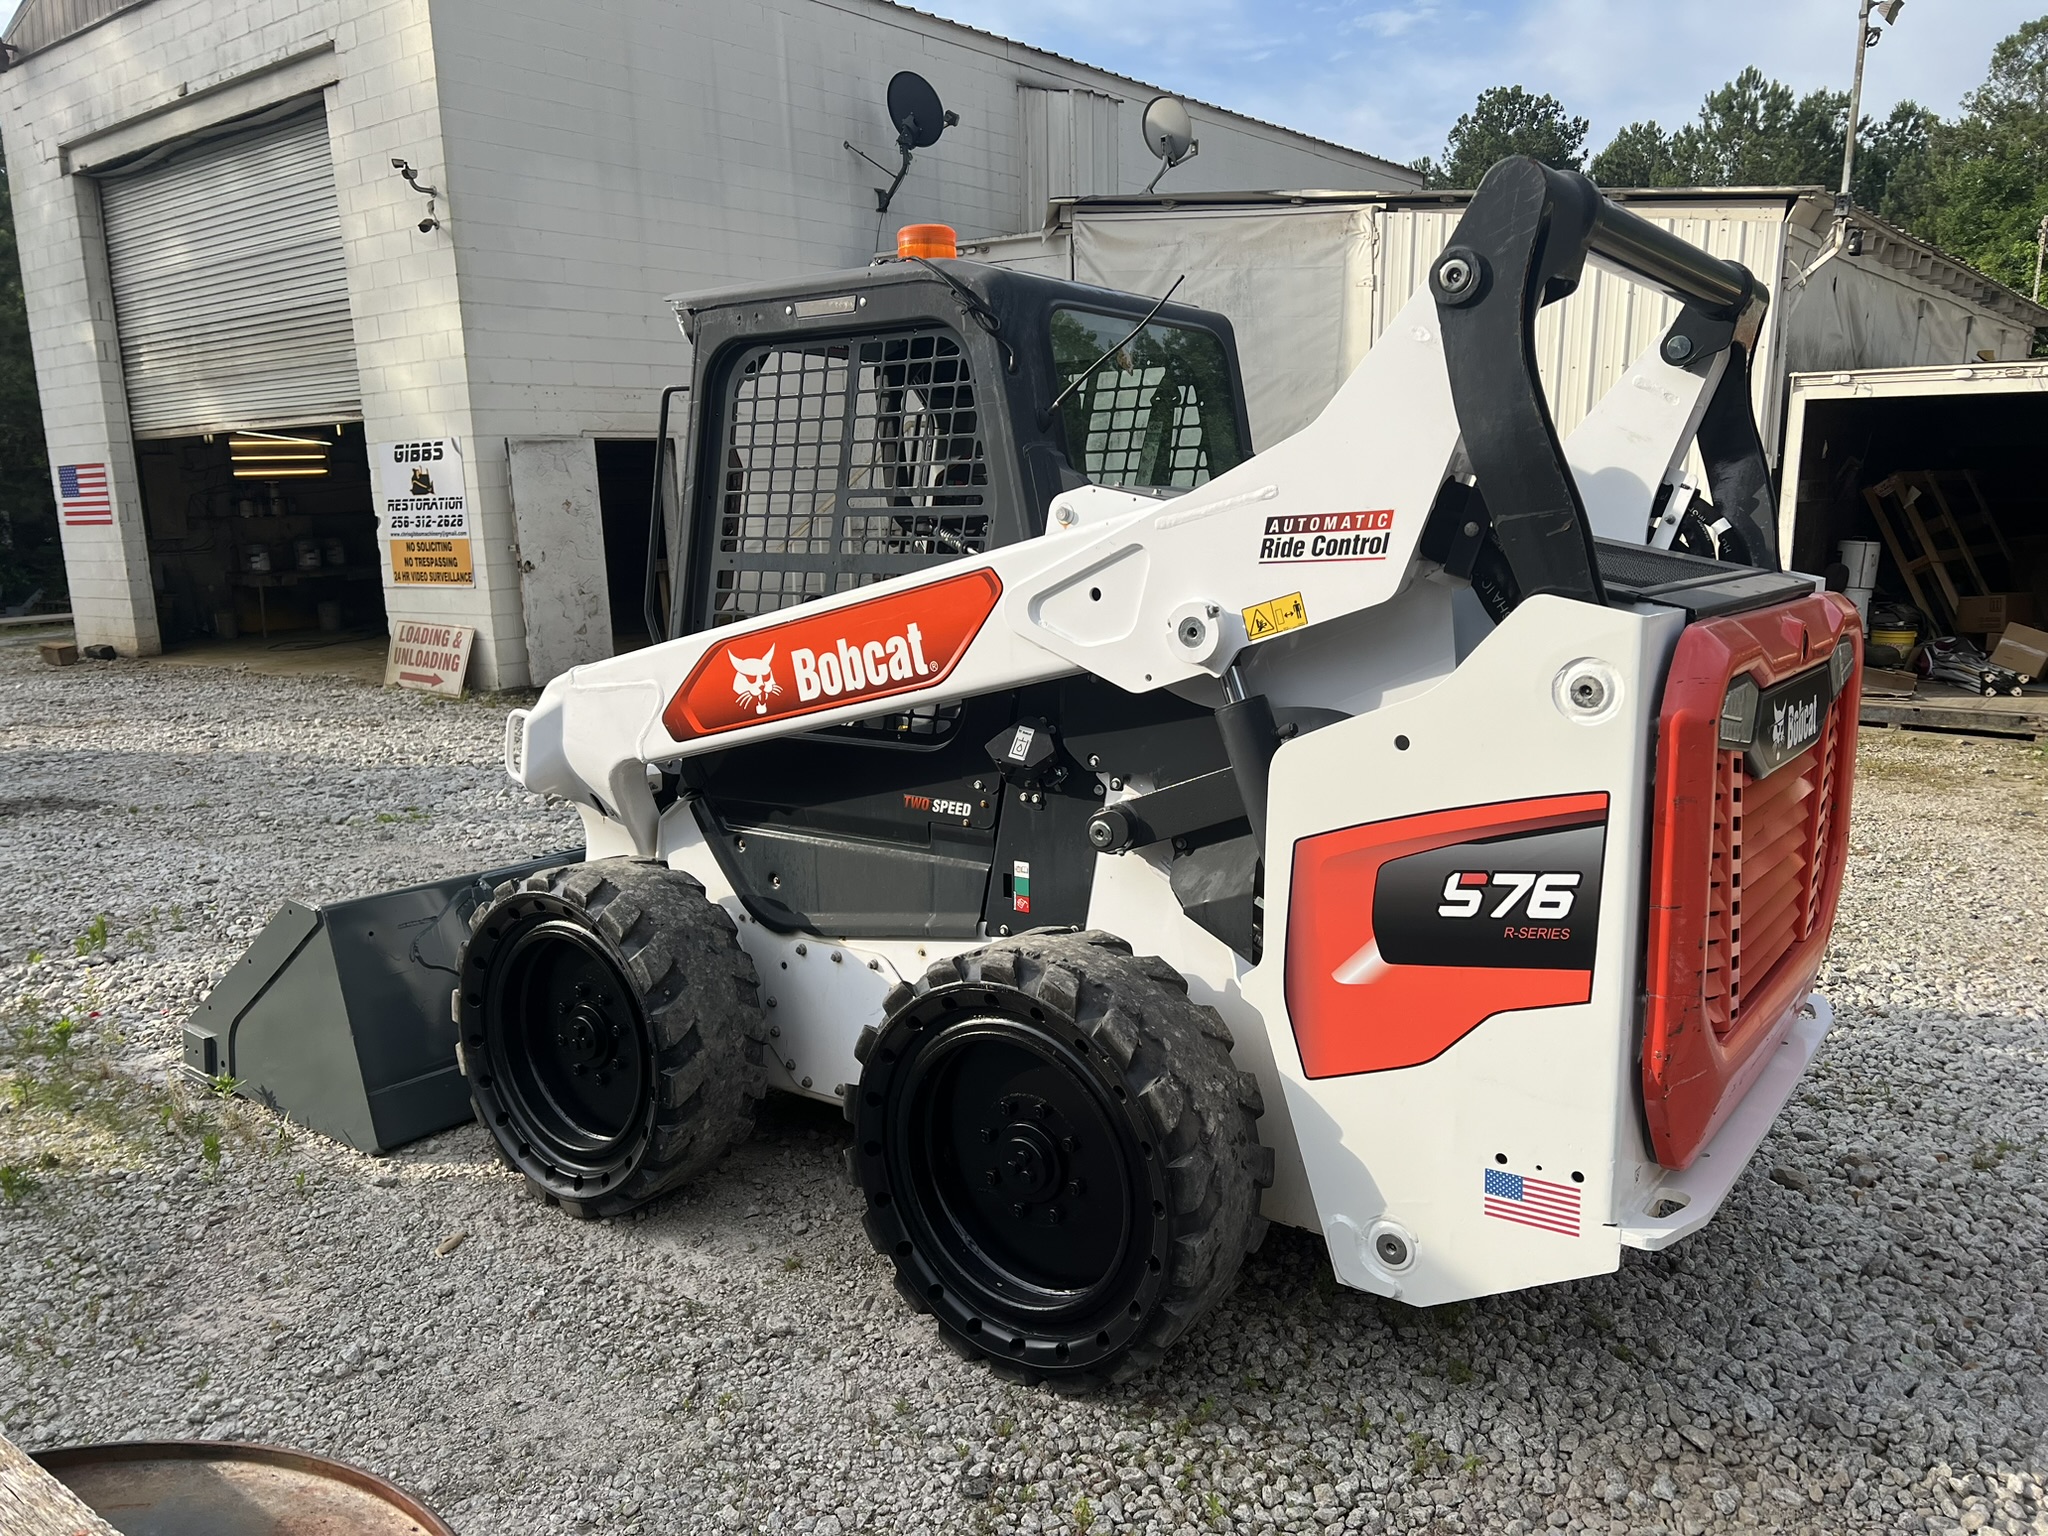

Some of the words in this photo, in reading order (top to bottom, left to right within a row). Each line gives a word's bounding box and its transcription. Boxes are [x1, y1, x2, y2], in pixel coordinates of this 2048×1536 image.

[394, 441, 443, 463] GIBBS
[387, 496, 463, 512] RESTORATION
[1268, 513, 1388, 534] AUTOMATIC
[406, 542, 415, 552] NO
[416, 541, 453, 552] SOLICITING
[1259, 537, 1306, 559] Ride
[1311, 532, 1391, 557] Control
[404, 557, 414, 568] NO
[414, 557, 458, 568] TRESPASSING
[394, 571, 402, 582] 24
[402, 571, 411, 582] HR
[411, 571, 429, 582] VIDEO
[429, 571, 473, 583] SURVEILLANCE
[398, 625, 450, 647] LOADING
[452, 631, 463, 649] &
[393, 647, 461, 673] UNLOADING
[1787, 694, 1817, 750] Bobcat
[904, 795, 930, 811] TWO
[931, 799, 972, 817] SPEED
[1438, 871, 1582, 920] S76
[1504, 926, 1571, 940] R-SERIES
